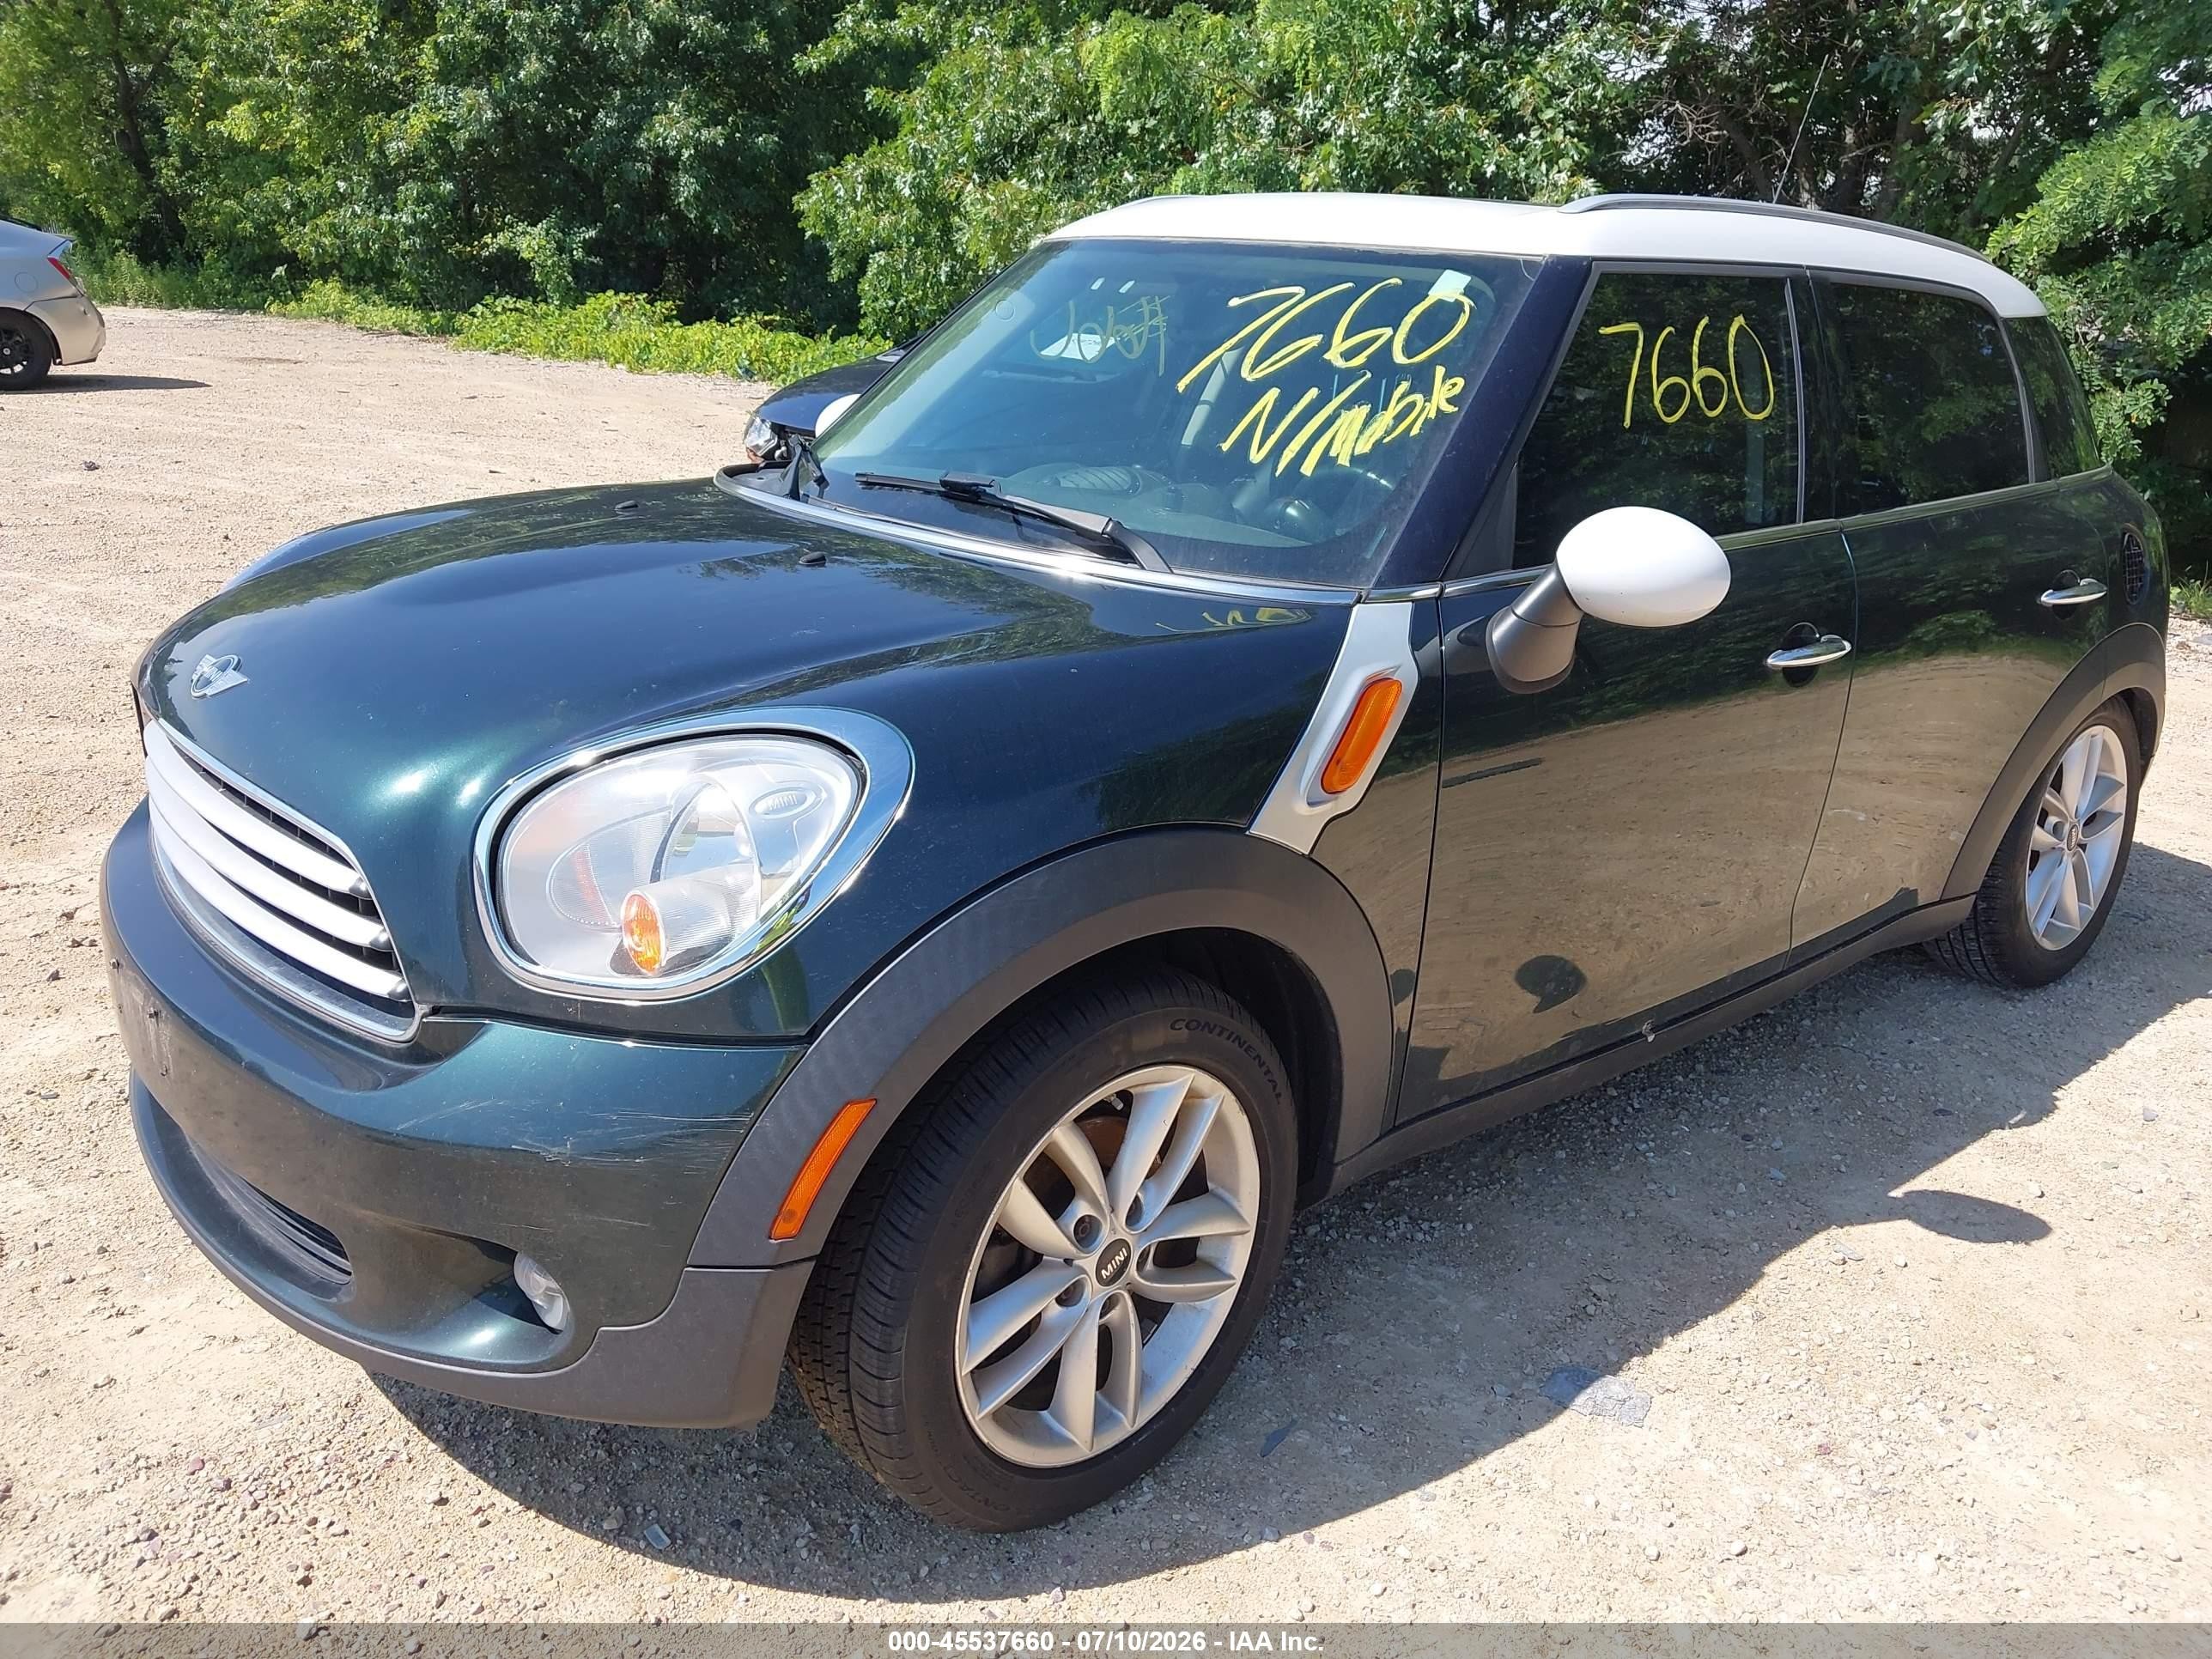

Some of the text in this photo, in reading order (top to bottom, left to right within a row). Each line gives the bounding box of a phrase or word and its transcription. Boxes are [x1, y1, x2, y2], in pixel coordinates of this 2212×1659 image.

[1176, 277, 1477, 392] 7660
[1598, 313, 1774, 429] 7660
[1170, 1018, 1282, 1105] CONTINENTAL
[1101, 1248, 1127, 1279] MINI
